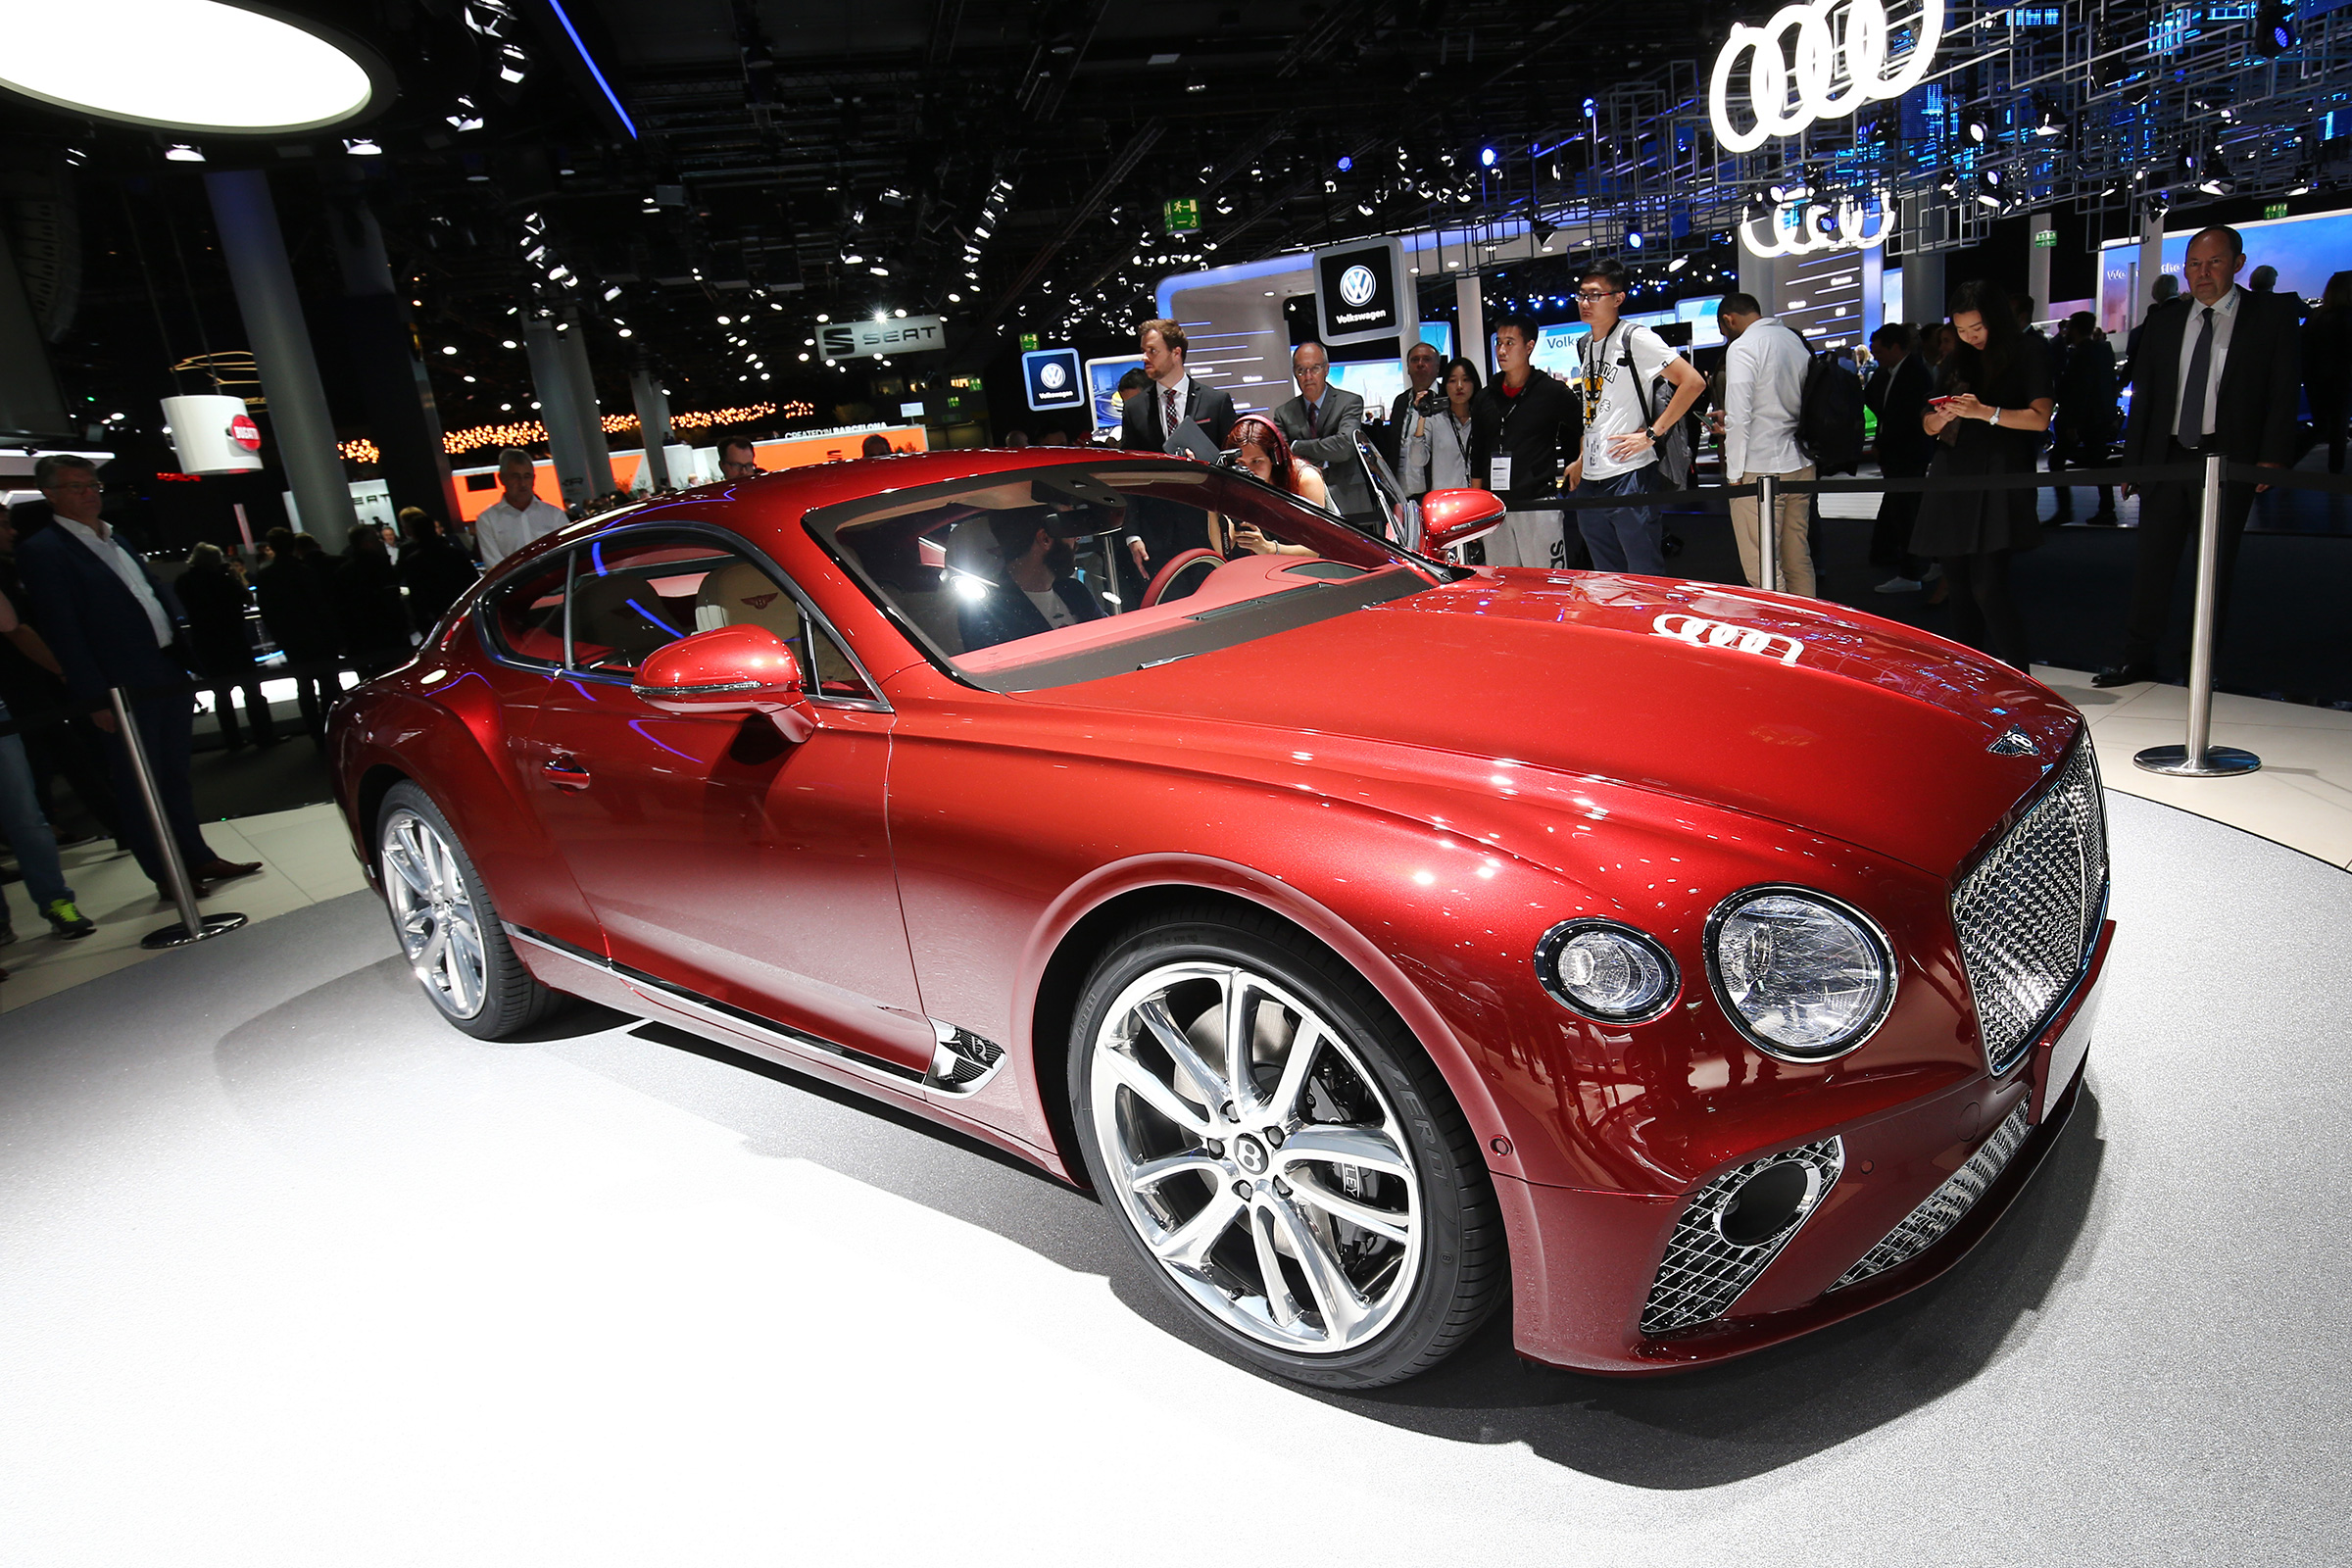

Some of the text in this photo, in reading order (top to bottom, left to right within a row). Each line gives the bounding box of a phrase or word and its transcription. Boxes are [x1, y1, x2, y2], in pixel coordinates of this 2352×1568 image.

[2161, 262, 2181, 273] the
[1336, 310, 1387, 323] Volkswagen
[862, 326, 937, 345] SEAT
[785, 429, 823, 439] CREATED
[833, 421, 888, 433] BARCELONA
[353, 494, 391, 505] EAT
[1381, 1060, 1447, 1180] ZERO
[1237, 1139, 1262, 1172] B
[1345, 1165, 1357, 1198] LEY
